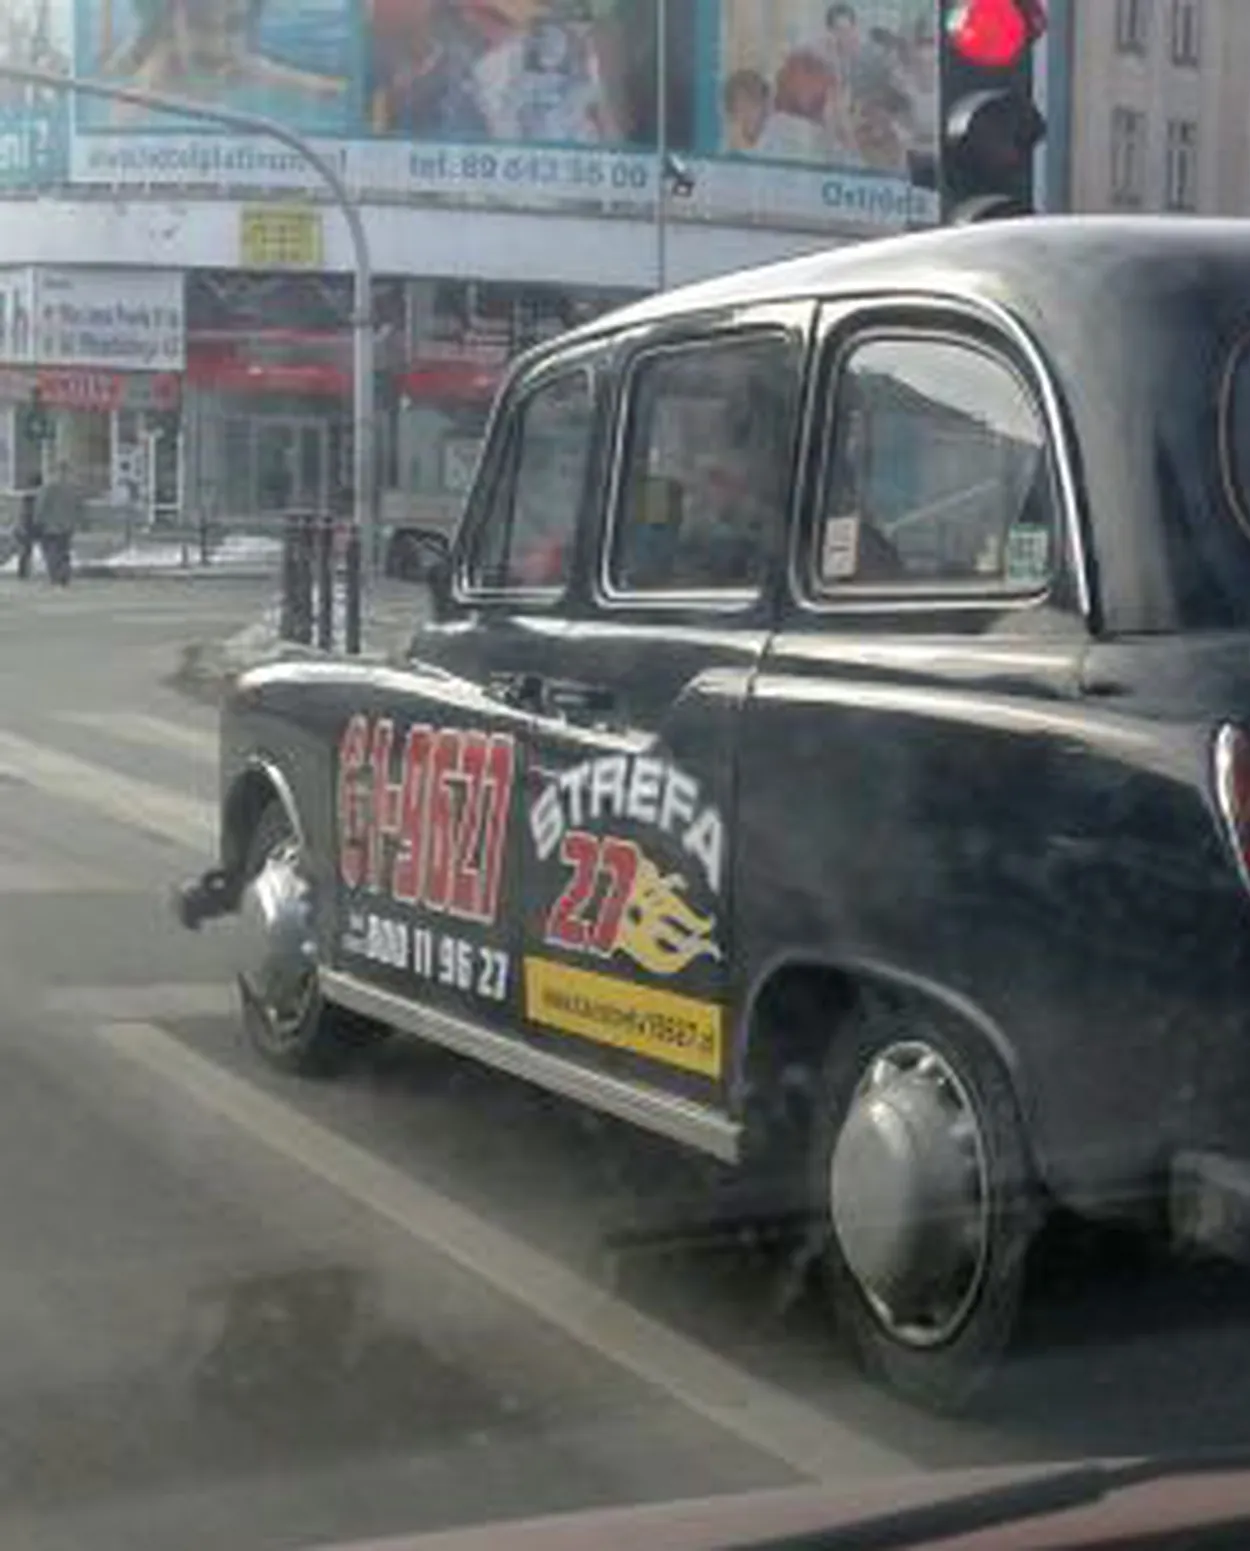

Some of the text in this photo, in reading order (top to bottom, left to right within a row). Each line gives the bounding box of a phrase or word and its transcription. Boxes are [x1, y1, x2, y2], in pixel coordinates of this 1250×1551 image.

[531, 756, 722, 893] STREFA
[543, 830, 640, 959] 27
[477, 946, 509, 1001] 27
